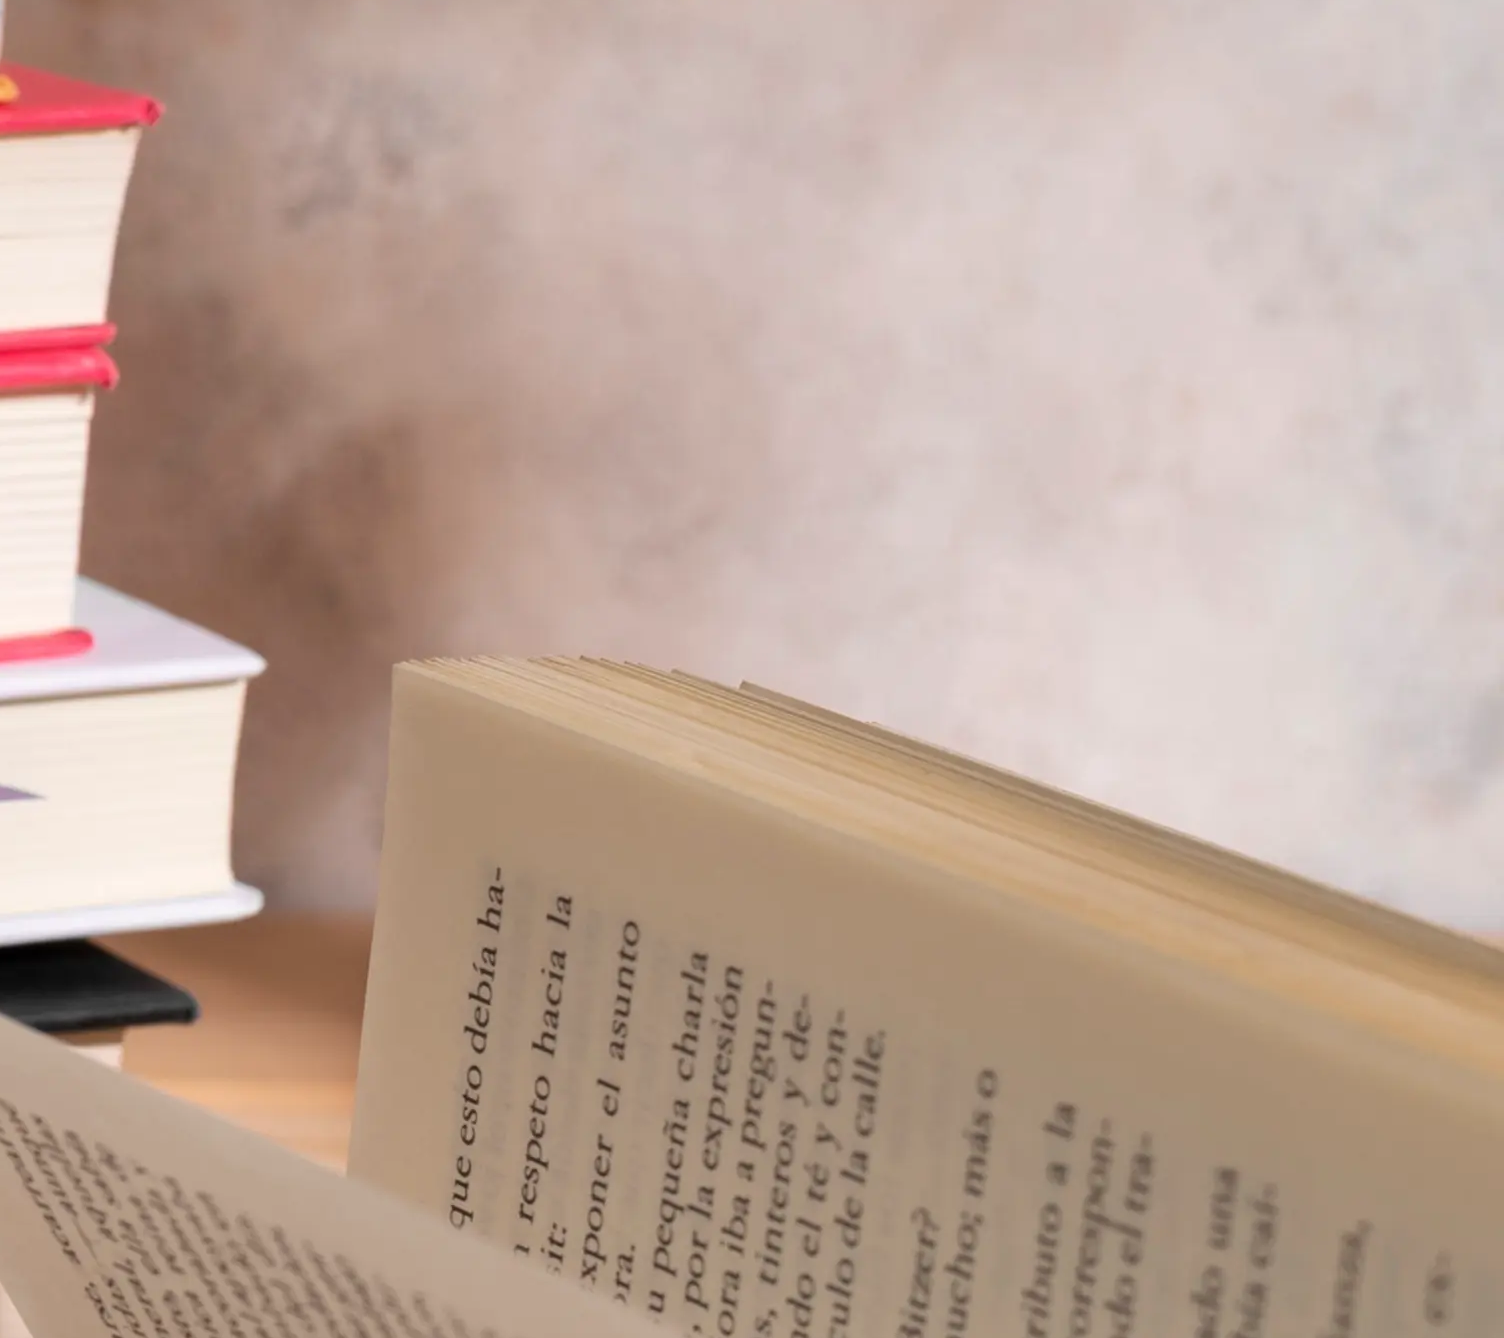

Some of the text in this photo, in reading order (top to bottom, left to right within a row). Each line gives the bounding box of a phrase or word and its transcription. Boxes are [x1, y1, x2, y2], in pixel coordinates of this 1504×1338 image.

[449, 867, 505, 1229] que esto debía ha-
[519, 894, 573, 1224] respeto hacia la
[783, 992, 812, 1063] de-
[580, 920, 641, 1292] xponer el asunto
[652, 950, 709, 1278] pequeña charla
[720, 979, 777, 1259] iba a pregun-
[784, 1079, 811, 1107] y
[851, 1029, 886, 1139] calle.
[977, 1068, 998, 1100] o
[1042, 1101, 1077, 1142] la
[684, 964, 744, 1311] por la expresión
[796, 1009, 847, 1259] el té y con-
[840, 1150, 869, 1186] la
[962, 1110, 994, 1199] más
[1045, 1162, 1071, 1188] a
[756, 1121, 797, 1288] tinteros
[834, 1195, 864, 1250] de
[1207, 1165, 1240, 1252] una
